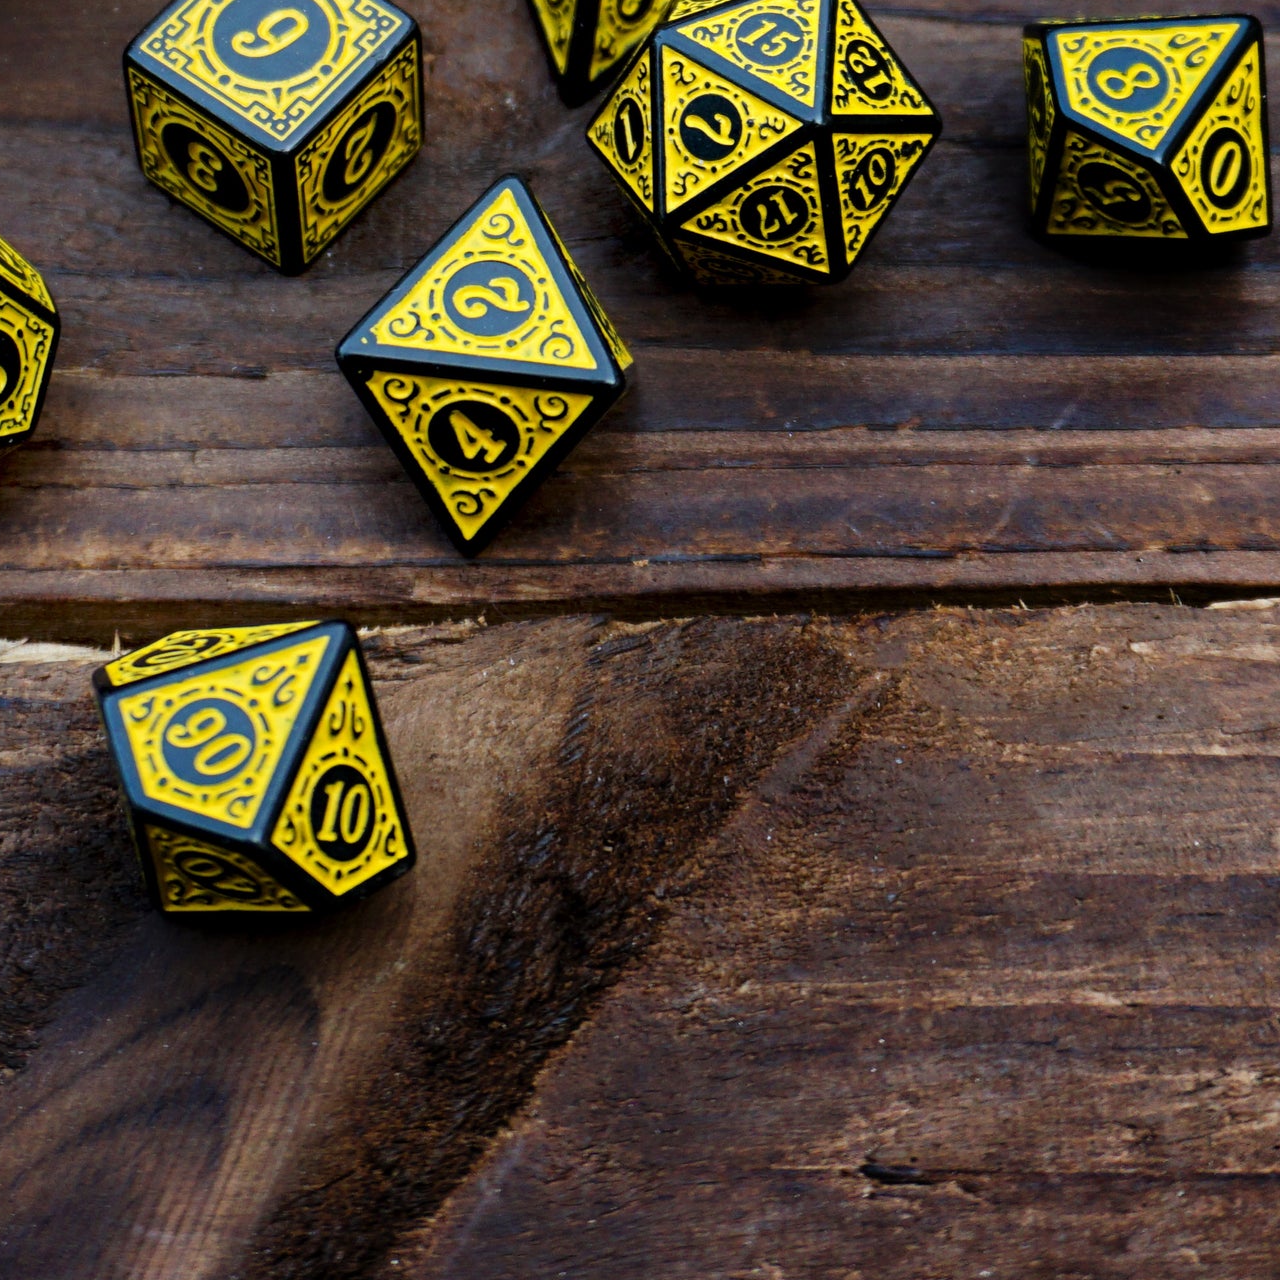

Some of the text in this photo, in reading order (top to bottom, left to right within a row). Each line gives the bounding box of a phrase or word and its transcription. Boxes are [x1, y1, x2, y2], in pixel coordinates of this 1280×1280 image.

[737, 19, 801, 57] 15
[848, 45, 889, 95] 12
[1096, 62, 1160, 100] 8
[344, 111, 379, 185] 2
[620, 103, 638, 160] 1
[684, 112, 735, 147] 7
[188, 141, 223, 192] 3
[855, 153, 887, 208] 10
[1211, 140, 1243, 197] 0
[755, 189, 799, 240] 17
[1084, 179, 1141, 206] 5
[452, 276, 531, 319] 2
[448, 409, 508, 464] 4
[165, 707, 253, 777] 90
[317, 780, 371, 845] 10
